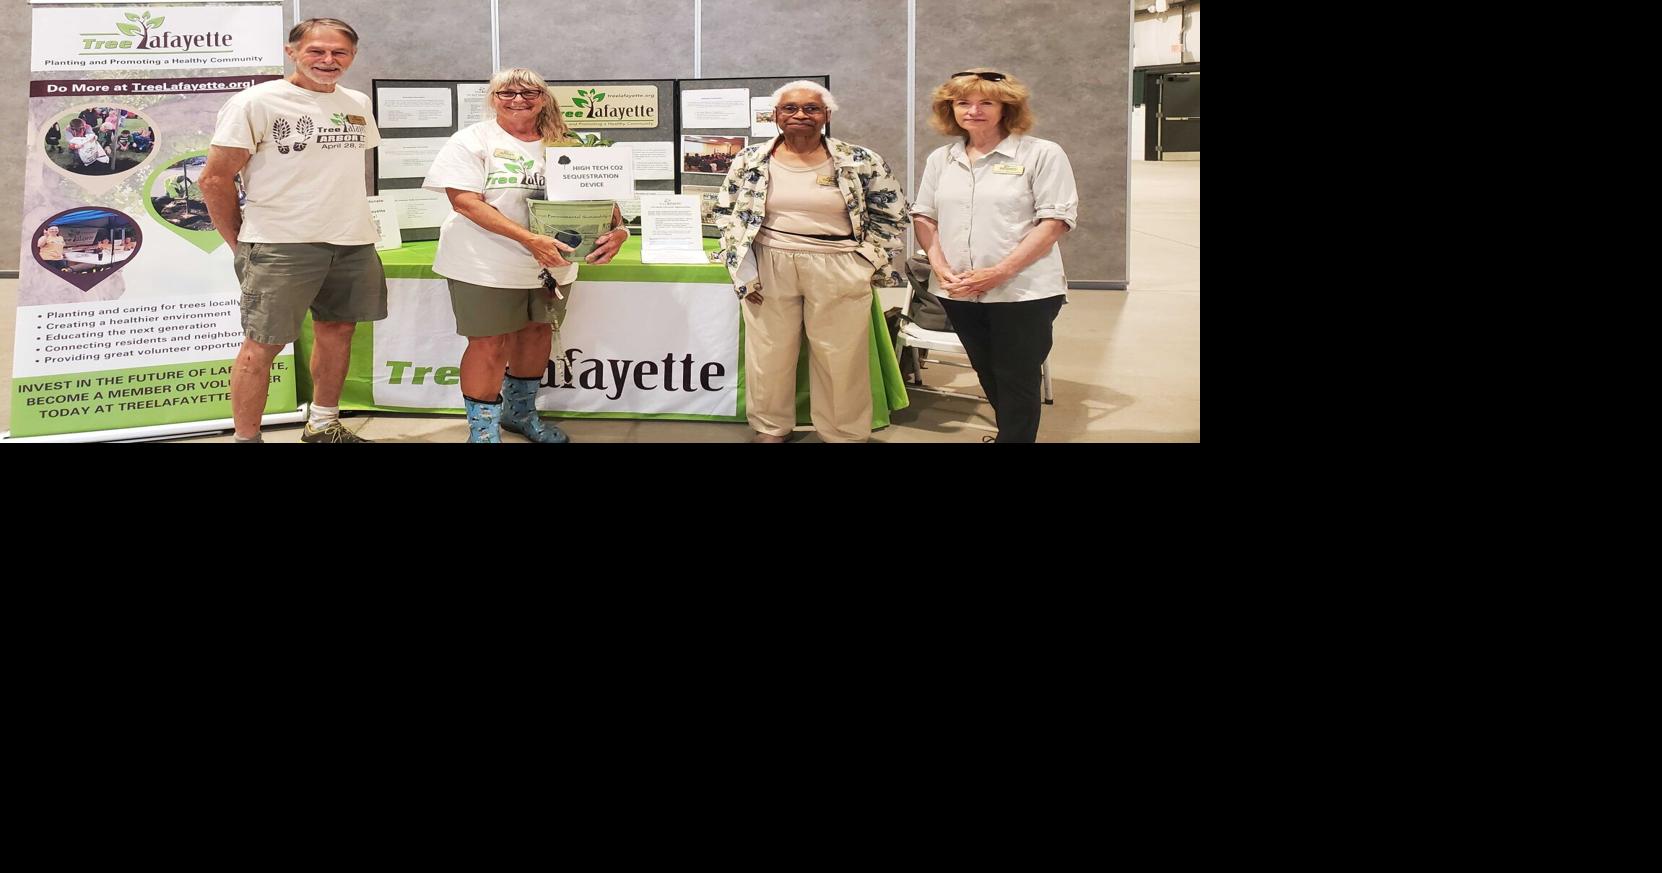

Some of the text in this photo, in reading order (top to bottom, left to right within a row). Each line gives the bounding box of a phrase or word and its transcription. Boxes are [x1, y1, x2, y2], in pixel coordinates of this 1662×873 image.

[82, 38, 133, 50] Tree
[44, 59, 86, 67] Planting
[110, 58, 161, 66] Promoting
[172, 57, 208, 65] Healthy
[210, 56, 263, 64] Community
[47, 80, 255, 93] Do More at TreeLafayette.org!
[561, 110, 584, 118] ree
[46, 320, 96, 330] Creating
[109, 316, 160, 325] healthier
[163, 310, 231, 320] environment
[47, 310, 95, 319] Planting
[98, 307, 120, 315] and
[123, 305, 157, 313] caring
[161, 303, 176, 311] for
[45, 330, 244, 352] Connecting residents and neighbor
[46, 331, 104, 341] Educating
[129, 327, 155, 335] next
[158, 322, 217, 333] generation
[44, 341, 244, 364] Providing great volunteer opportun
[18, 380, 73, 393] INVEST
[76, 378, 91, 388] IN
[95, 375, 124, 386] THE
[128, 370, 184, 383] FUTURE
[188, 368, 207, 378] OF
[386, 360, 460, 385] Tre
[26, 393, 89, 406] BECOME
[93, 391, 103, 400] A
[108, 385, 171, 398] MEMBER
[175, 382, 195, 392] OR
[40, 406, 90, 418] TODAY
[94, 404, 114, 414] AT
